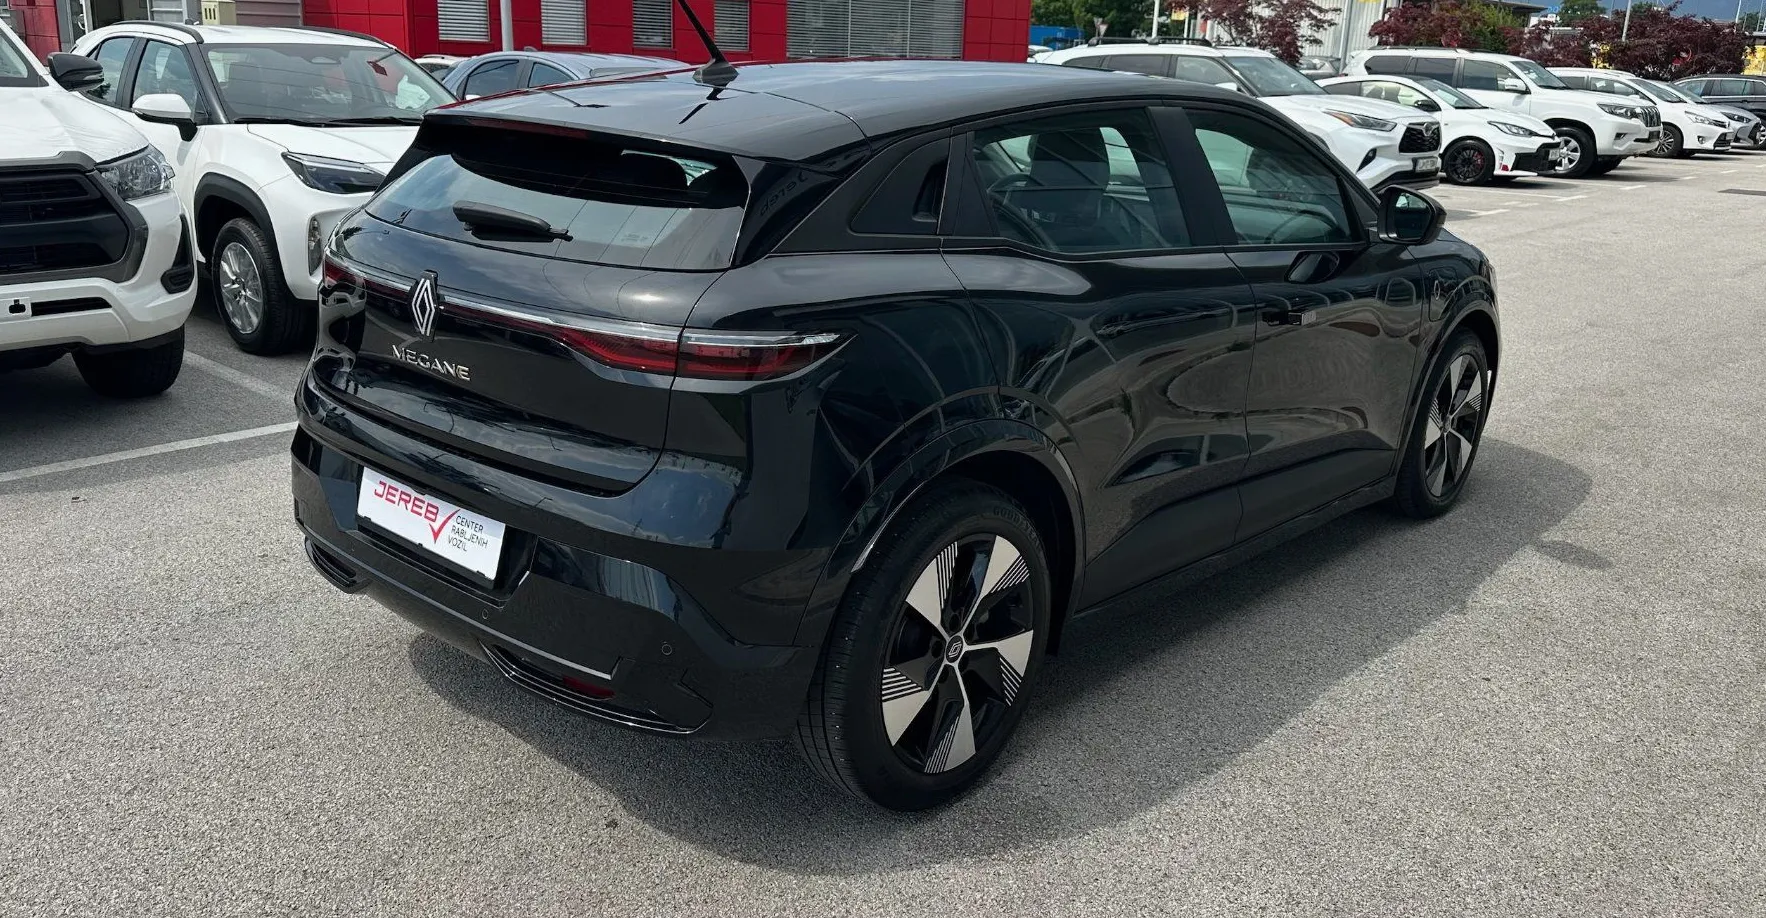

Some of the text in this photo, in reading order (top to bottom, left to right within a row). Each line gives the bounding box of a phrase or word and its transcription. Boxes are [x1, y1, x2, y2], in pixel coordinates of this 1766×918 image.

[392, 344, 471, 381] MEGANE
[374, 480, 440, 523] JEREB
[455, 515, 484, 534] CENTER
[448, 535, 467, 551] VOZIL
[451, 525, 488, 549] RABLJENIH
